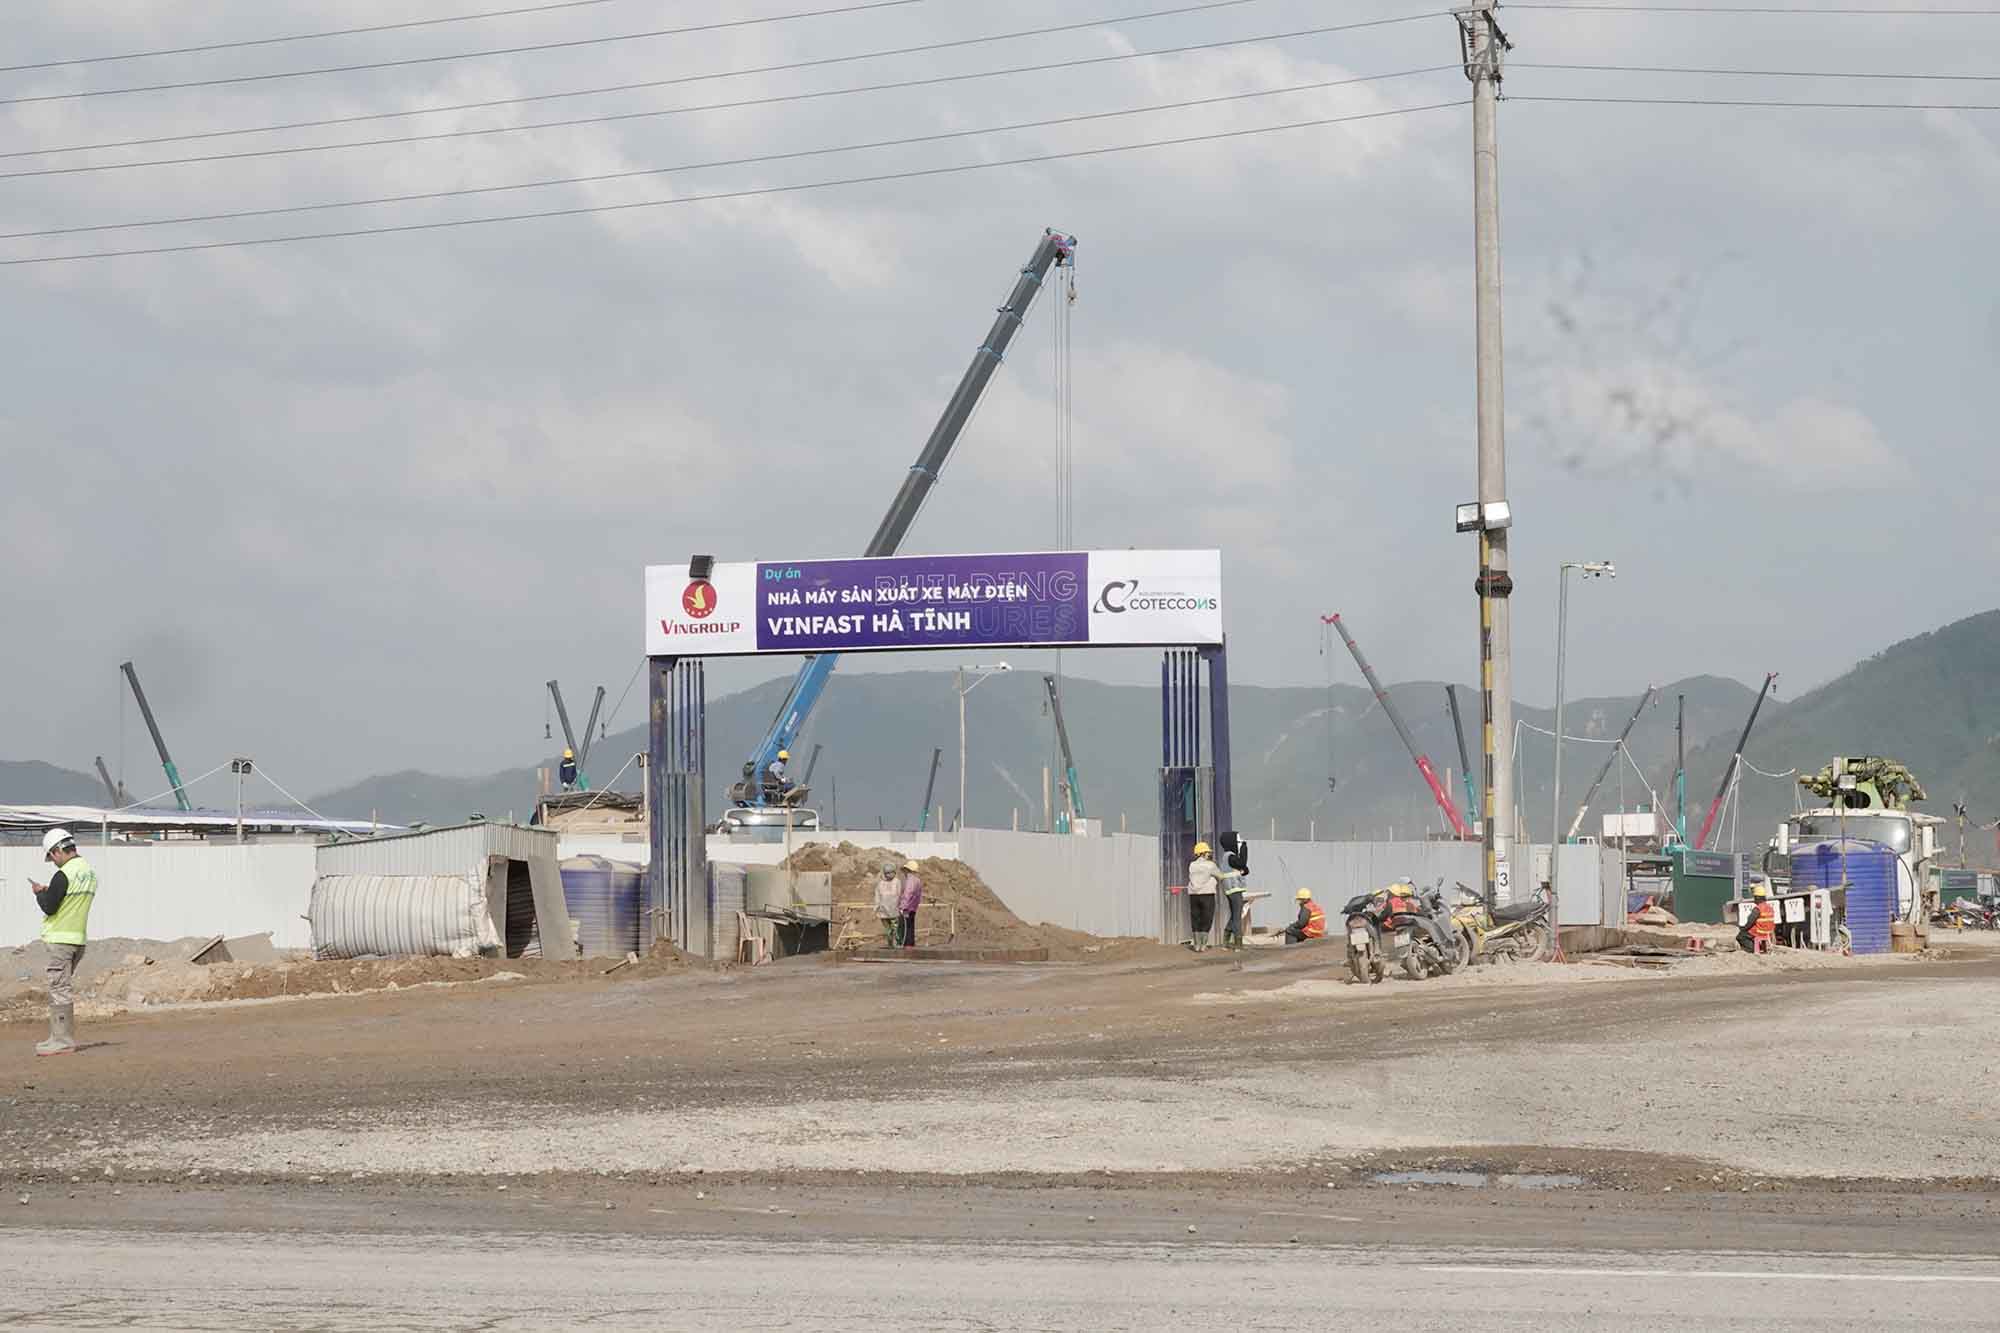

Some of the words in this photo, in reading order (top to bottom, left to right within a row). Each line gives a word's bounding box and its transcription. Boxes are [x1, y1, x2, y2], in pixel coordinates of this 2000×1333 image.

[765, 568, 782, 582] Dự
[785, 567, 801, 579] án
[767, 590, 801, 605] NHÀ
[805, 587, 837, 604] MÁY
[841, 586, 872, 603] SẢN
[876, 582, 918, 601] XUẤT
[921, 586, 943, 600] XE
[948, 583, 981, 599] MÁY
[984, 581, 1028, 601] ĐIỆN
[660, 620, 741, 635] VINGROUP
[767, 614, 865, 636] VINFAST
[872, 608, 904, 632] HÀ
[910, 608, 971, 631] TĨNH
